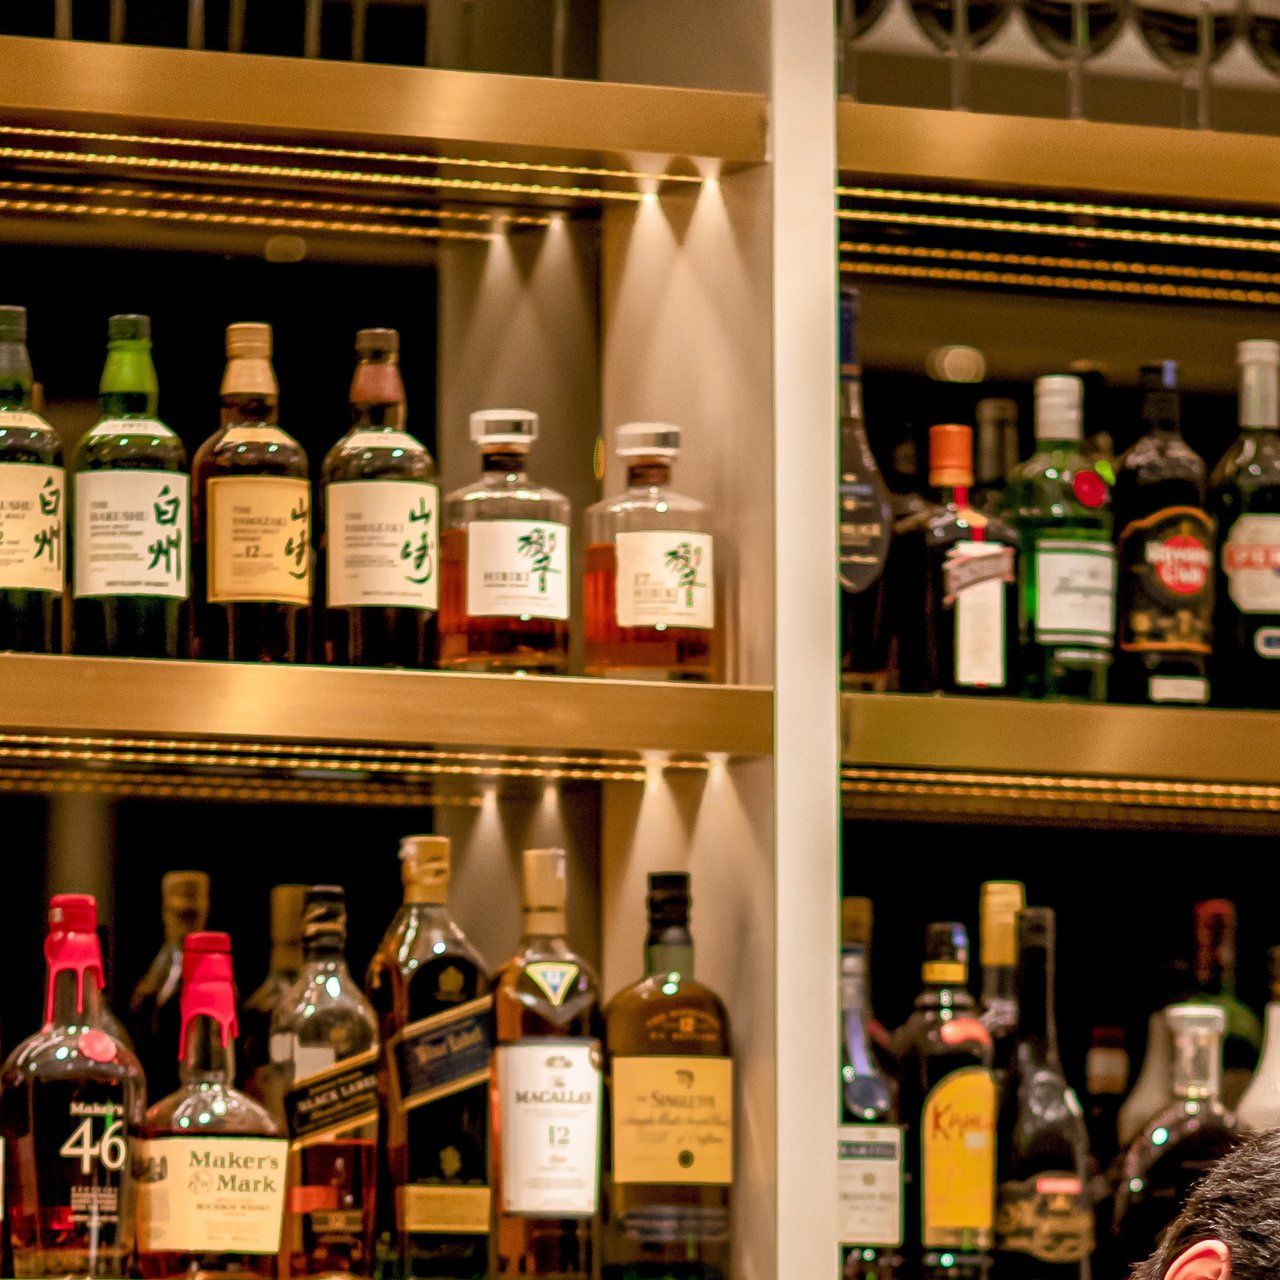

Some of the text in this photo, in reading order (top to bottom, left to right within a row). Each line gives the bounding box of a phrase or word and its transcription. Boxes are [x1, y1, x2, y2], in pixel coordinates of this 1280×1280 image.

[548, 1125, 570, 1145] 12
[58, 1117, 128, 1176] 46
[188, 1150, 279, 1170] Maker's
[217, 1174, 278, 1194] Mark
